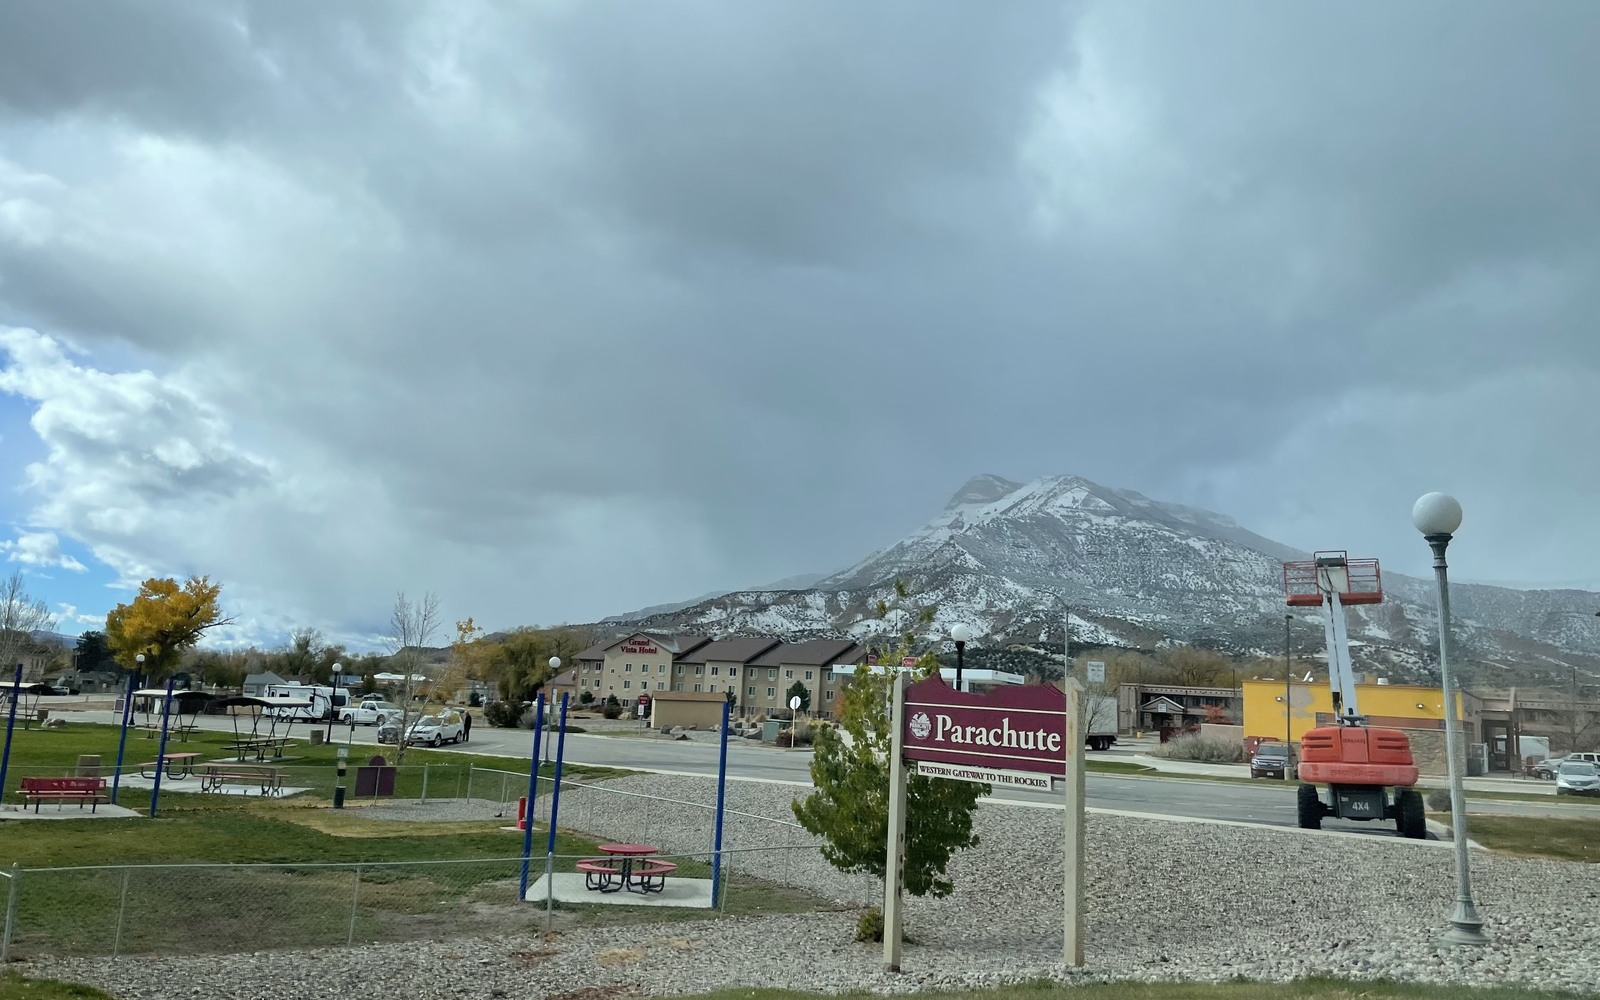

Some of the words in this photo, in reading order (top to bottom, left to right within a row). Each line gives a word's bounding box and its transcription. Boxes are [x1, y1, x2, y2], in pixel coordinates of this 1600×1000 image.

[935, 714, 1061, 752] Parachute
[919, 765, 951, 776] WESTERN
[952, 768, 986, 780] GATEWAY
[986, 773, 996, 781] TO
[997, 774, 1013, 783] THE
[1015, 777, 1048, 787] ROCKIES
[1352, 802, 1369, 811] 4X4
